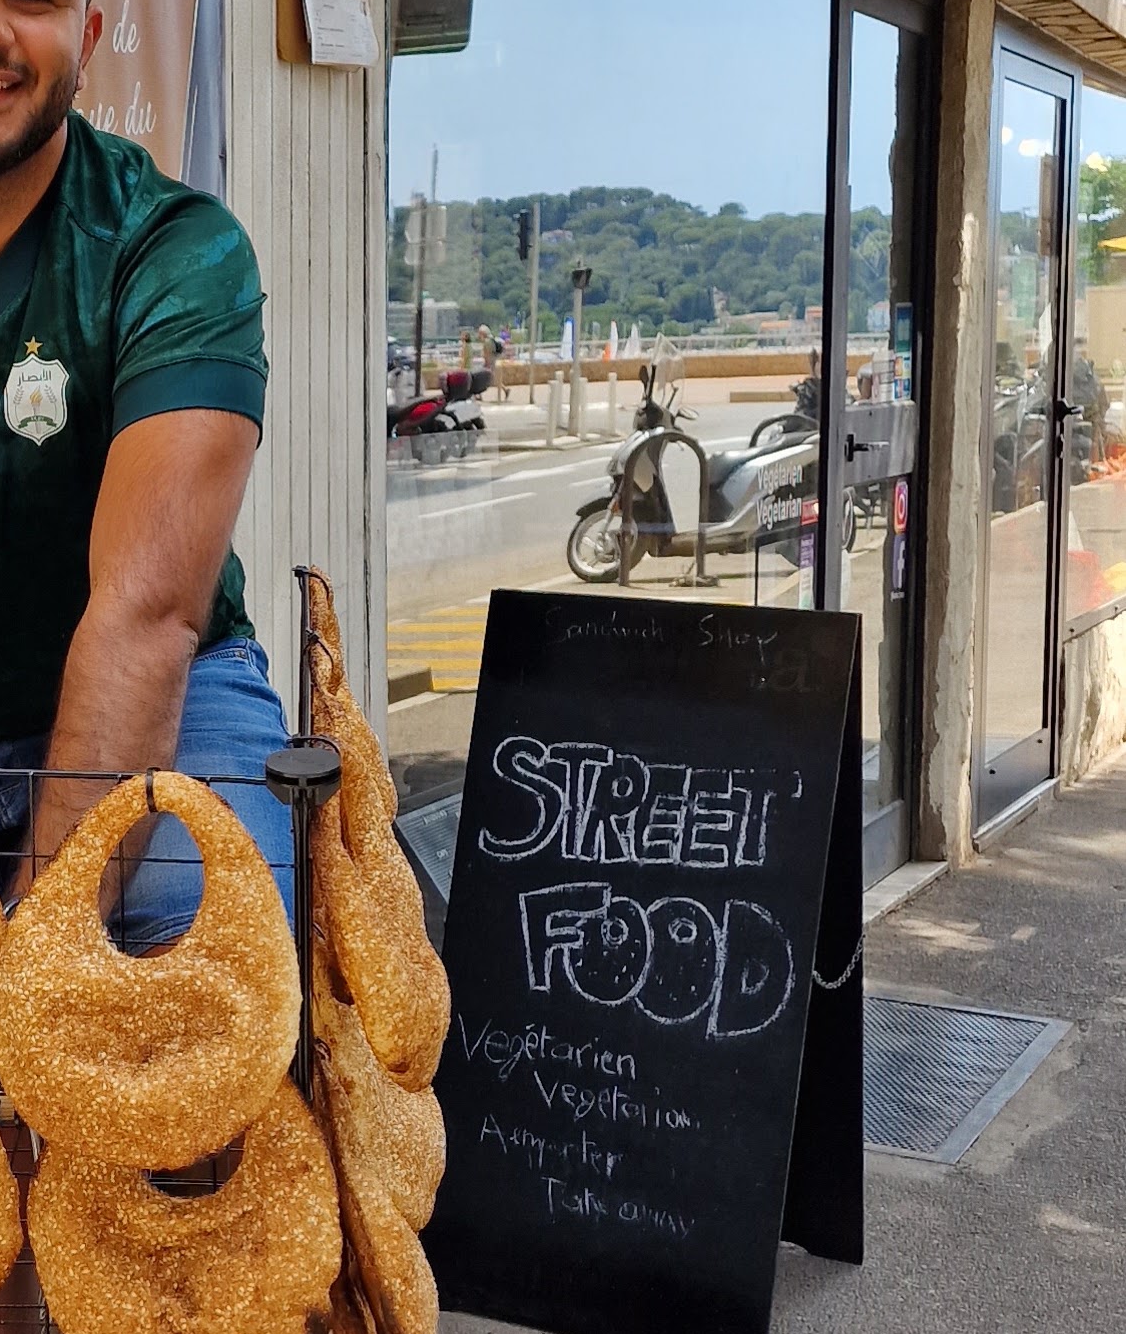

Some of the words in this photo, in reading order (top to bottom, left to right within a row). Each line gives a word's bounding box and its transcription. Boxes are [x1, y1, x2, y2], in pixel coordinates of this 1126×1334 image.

[124, 81, 157, 136] du
[756, 493, 802, 530] Vegetarian
[478, 735, 803, 868] STREET
[518, 880, 796, 1040] FOOD
